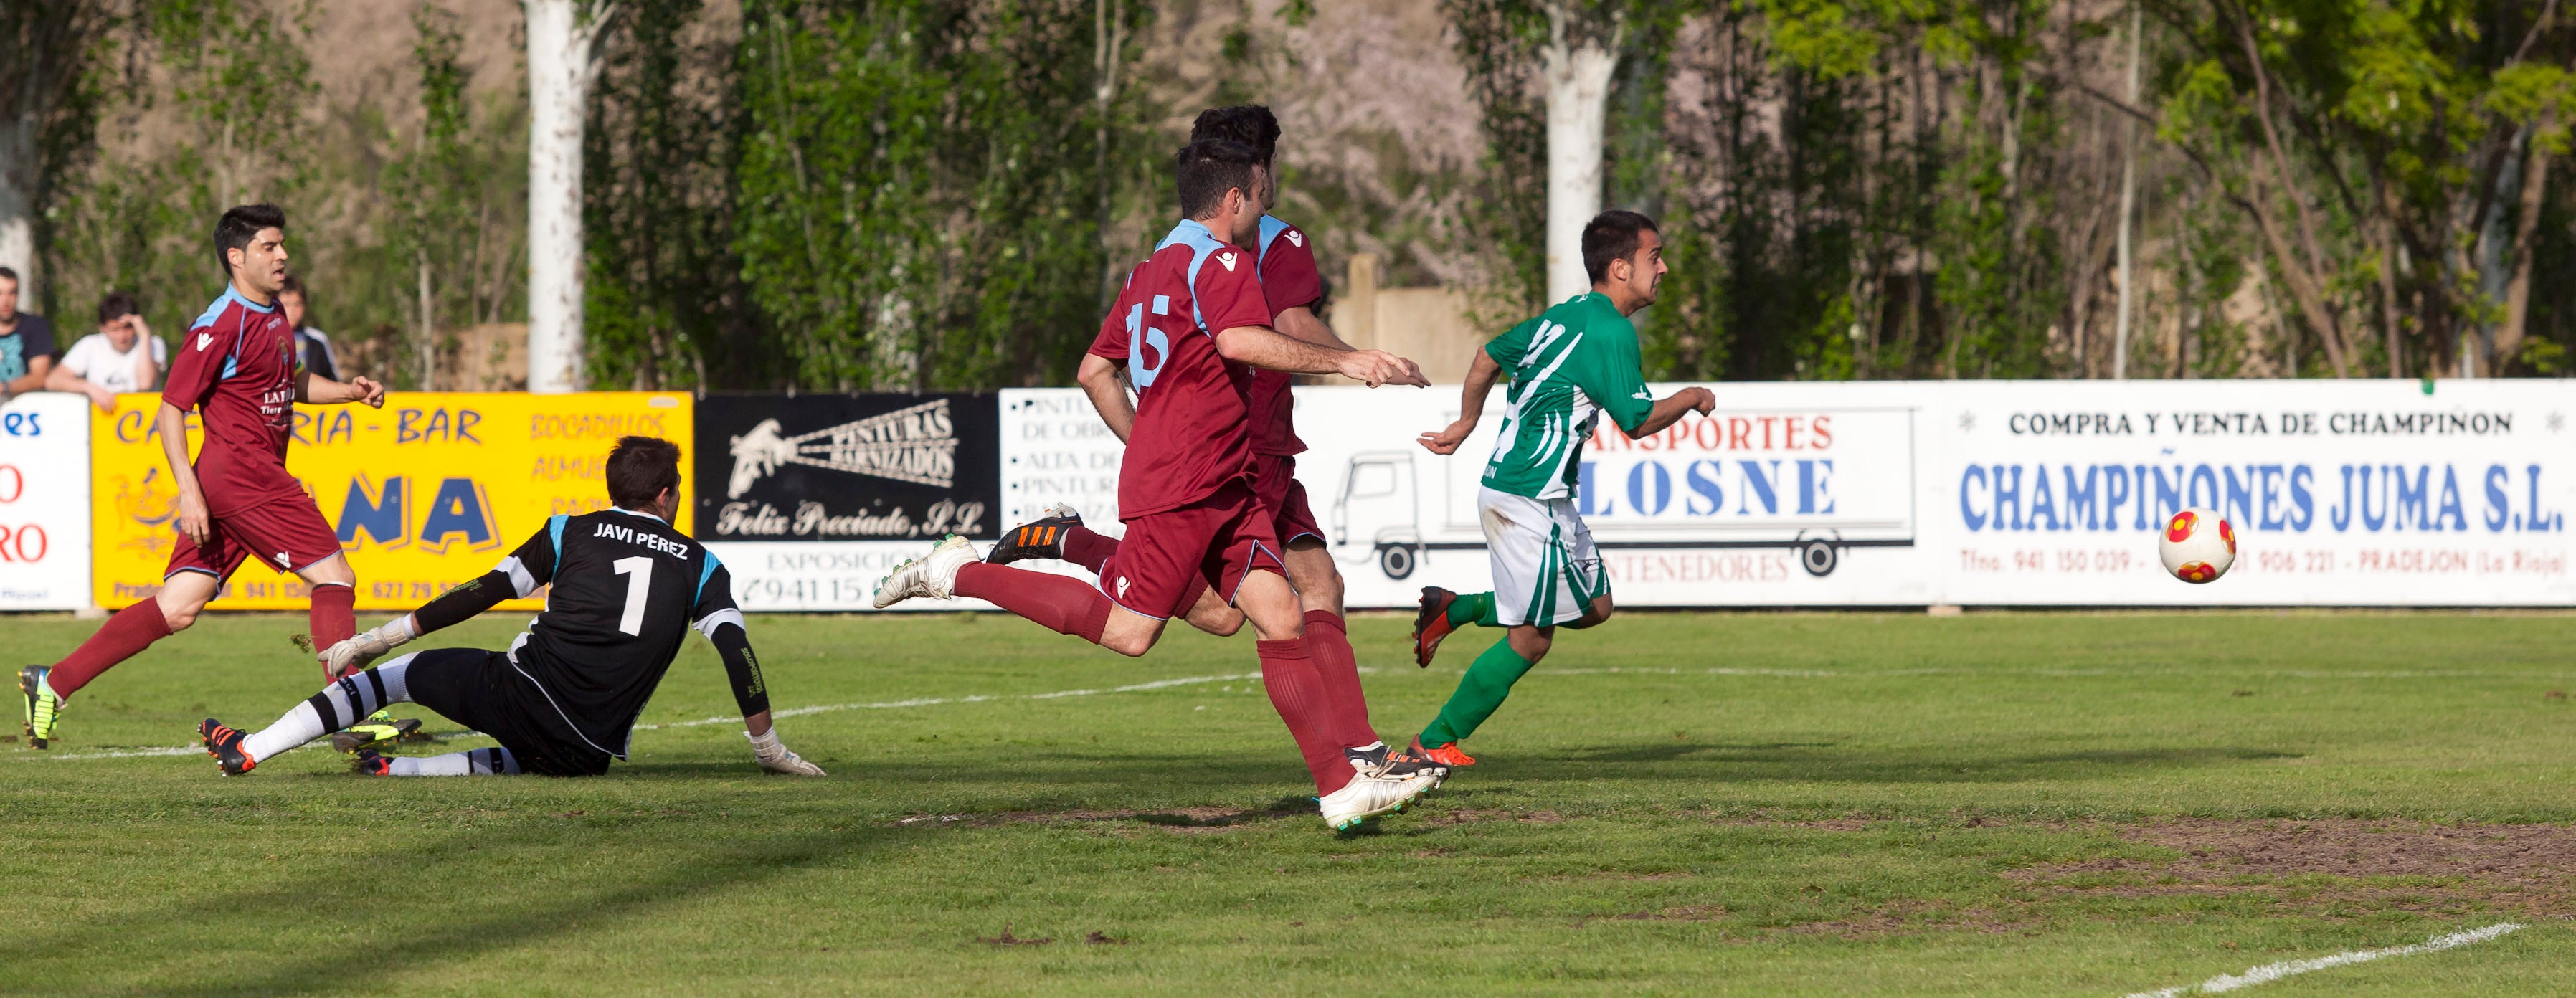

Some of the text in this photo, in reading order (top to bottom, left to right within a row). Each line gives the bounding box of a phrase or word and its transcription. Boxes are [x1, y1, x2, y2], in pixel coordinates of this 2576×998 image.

[1126, 294, 1170, 394] 15
[1023, 398, 1095, 415] PINTU
[4, 412, 41, 436] es
[397, 408, 481, 445] BAR
[530, 412, 666, 439] BOCADILLOS
[830, 406, 954, 447] PINTURAS
[1023, 422, 1112, 439] DE OBR
[1582, 414, 1833, 452] ANSPORTES
[2010, 413, 2133, 434] COMPRA
[2147, 412, 2162, 434] Y
[2174, 413, 2268, 434] VENTA
[2281, 413, 2319, 434] DE
[531, 454, 607, 481] ALMUE
[830, 445, 955, 480] BARNIZADOS
[1023, 452, 1080, 471] ALTA
[1023, 476, 1116, 495] PINTUR
[1579, 458, 1835, 517] LOSNE
[1960, 447, 2563, 533] CHAMPIÑONES JUMA S.L.
[716, 501, 790, 536] Felix
[792, 501, 919, 538] Preciado,
[593, 523, 688, 561] JAVI PEREZ
[1603, 553, 1789, 582] NTENEDORES
[2014, 550, 2044, 570] 941
[2058, 550, 2087, 571] 150
[2096, 550, 2130, 571] 039
[2259, 549, 2296, 571] 906
[2306, 549, 2335, 571] 221
[2360, 549, 2468, 571] PRADEJON
[245, 581, 276, 599] 941
[372, 582, 403, 599] 627
[411, 581, 432, 599] 29
[613, 556, 653, 637] 1
[765, 578, 817, 602] 941
